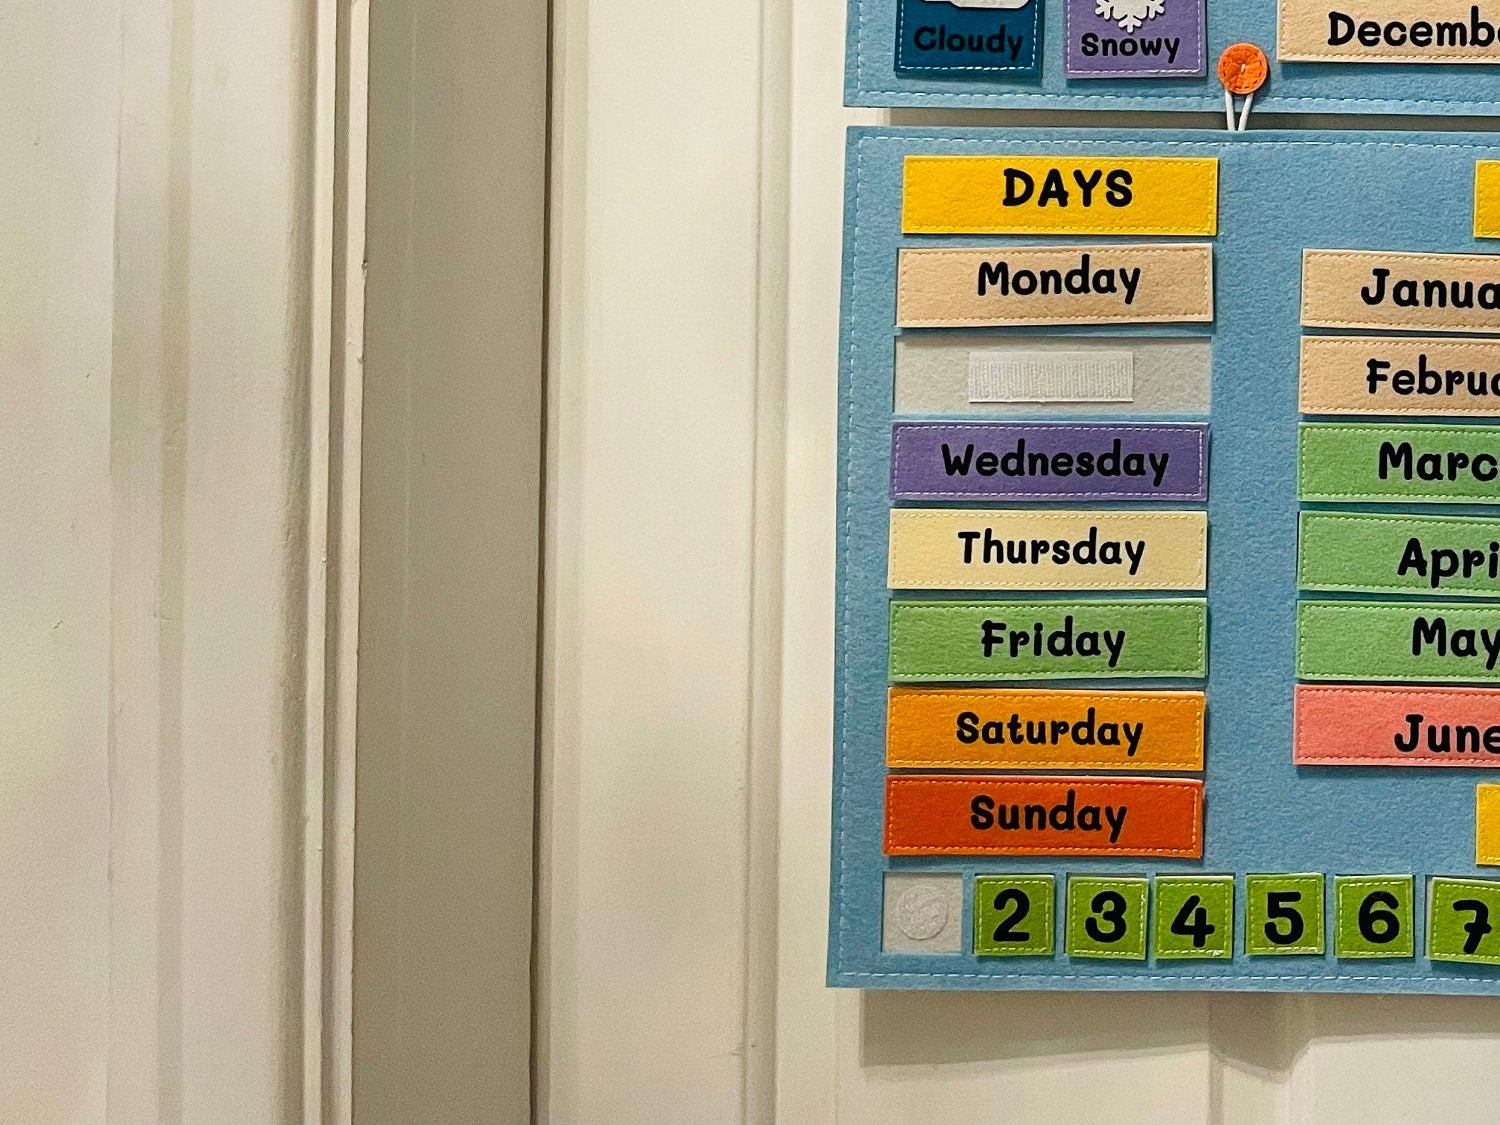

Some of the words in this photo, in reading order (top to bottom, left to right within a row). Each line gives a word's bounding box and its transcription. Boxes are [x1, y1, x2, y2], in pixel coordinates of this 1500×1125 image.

[914, 25, 1023, 62] Cloudy
[1082, 31, 1179, 63] Snowy
[1003, 168, 1132, 207] DAYS
[978, 254, 1140, 304] Monday
[942, 439, 1169, 487] Wednesday
[958, 527, 1145, 575] Thursday
[981, 615, 1125, 667] Friday
[957, 708, 1143, 756] Saturday
[971, 789, 1126, 843] Sunday
[993, 889, 1029, 942] 2
[1085, 891, 1126, 943] 3
[1171, 896, 1215, 947] 4
[1265, 892, 1303, 944] 5
[1358, 891, 1399, 943] 6
[1453, 900, 1492, 954] 7
